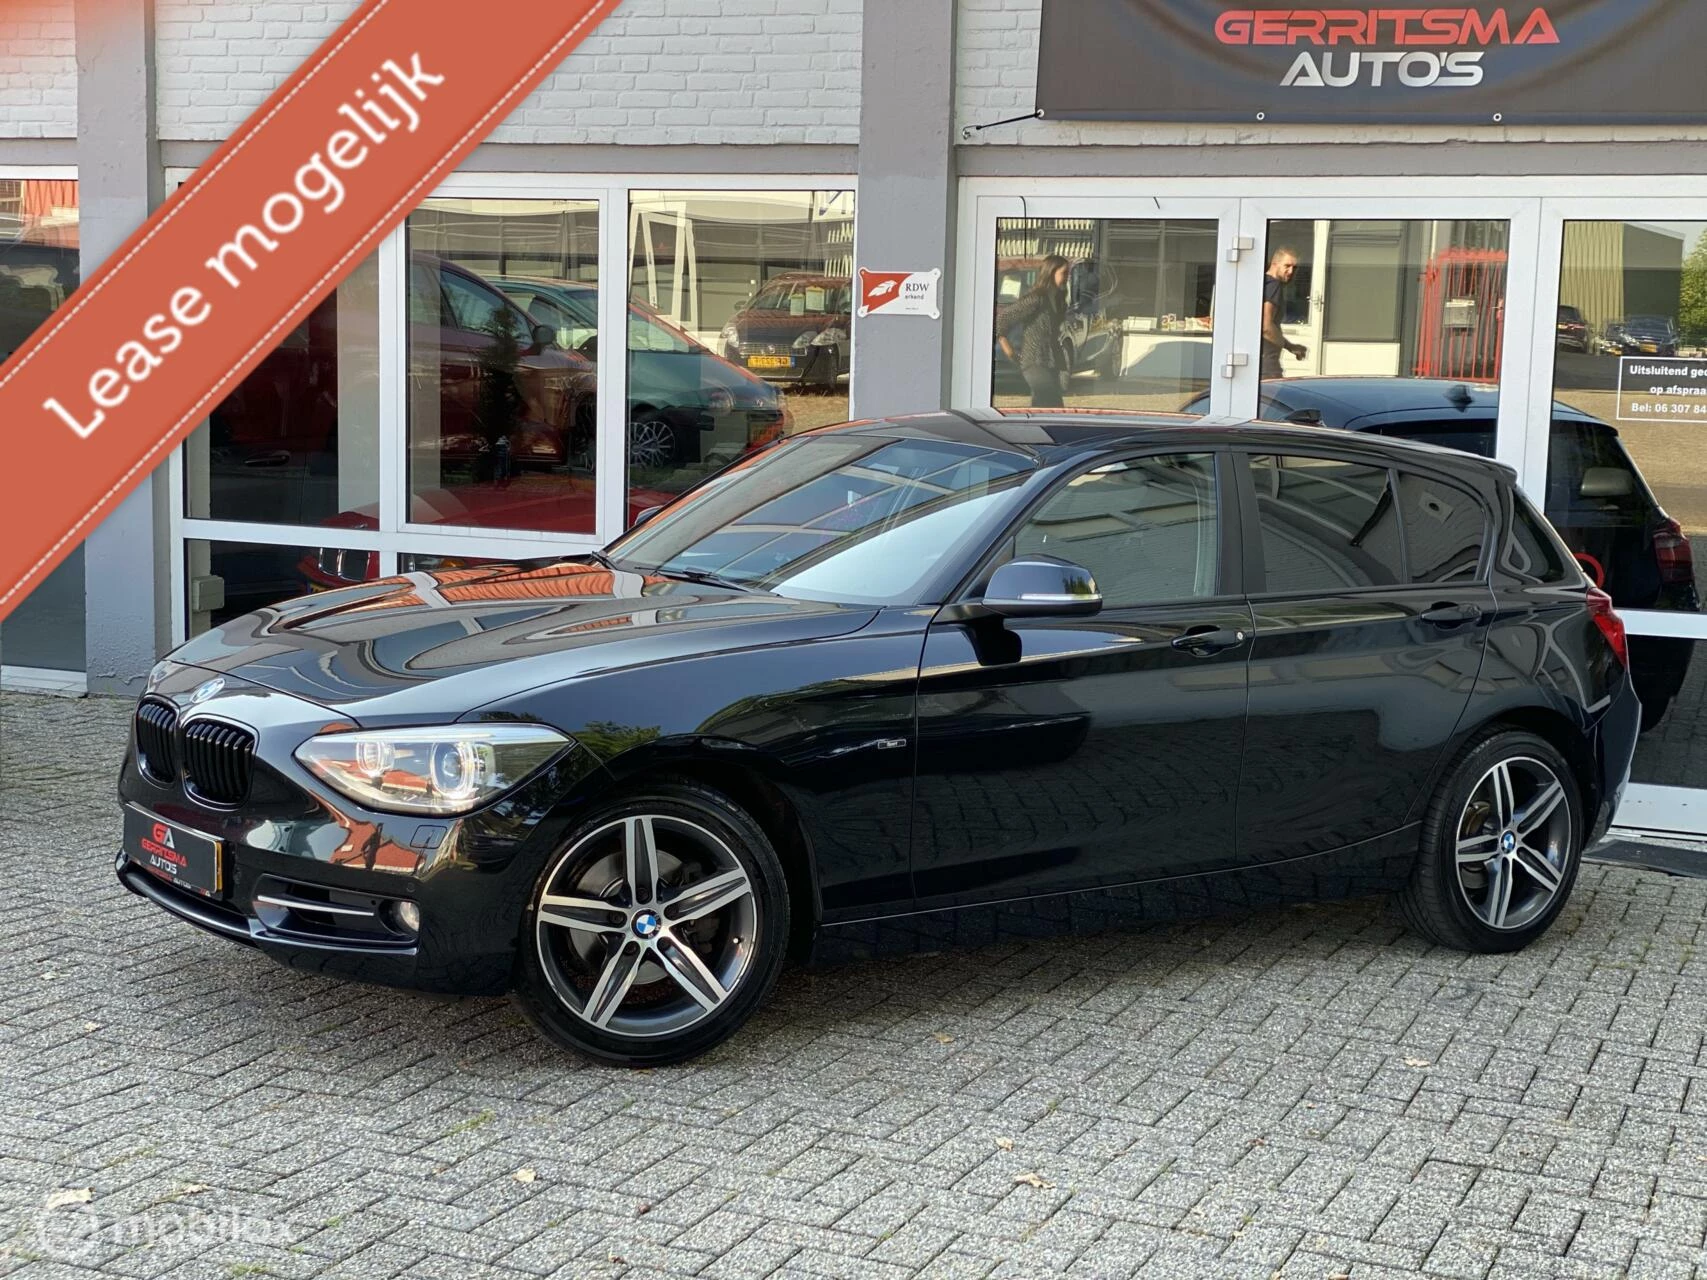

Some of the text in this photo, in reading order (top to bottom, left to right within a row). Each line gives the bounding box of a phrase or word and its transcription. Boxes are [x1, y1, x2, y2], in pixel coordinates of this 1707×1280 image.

[1214, 7, 1560, 45] GERRITSMA
[1279, 51, 1484, 87] AUTO'S
[905, 282, 929, 292] RDW
[1630, 365, 1688, 376] Uitsluitend
[1650, 386, 1663, 395] op
[1631, 402, 1706, 413] Bel: 06 307 84
[153, 822, 175, 849] GA
